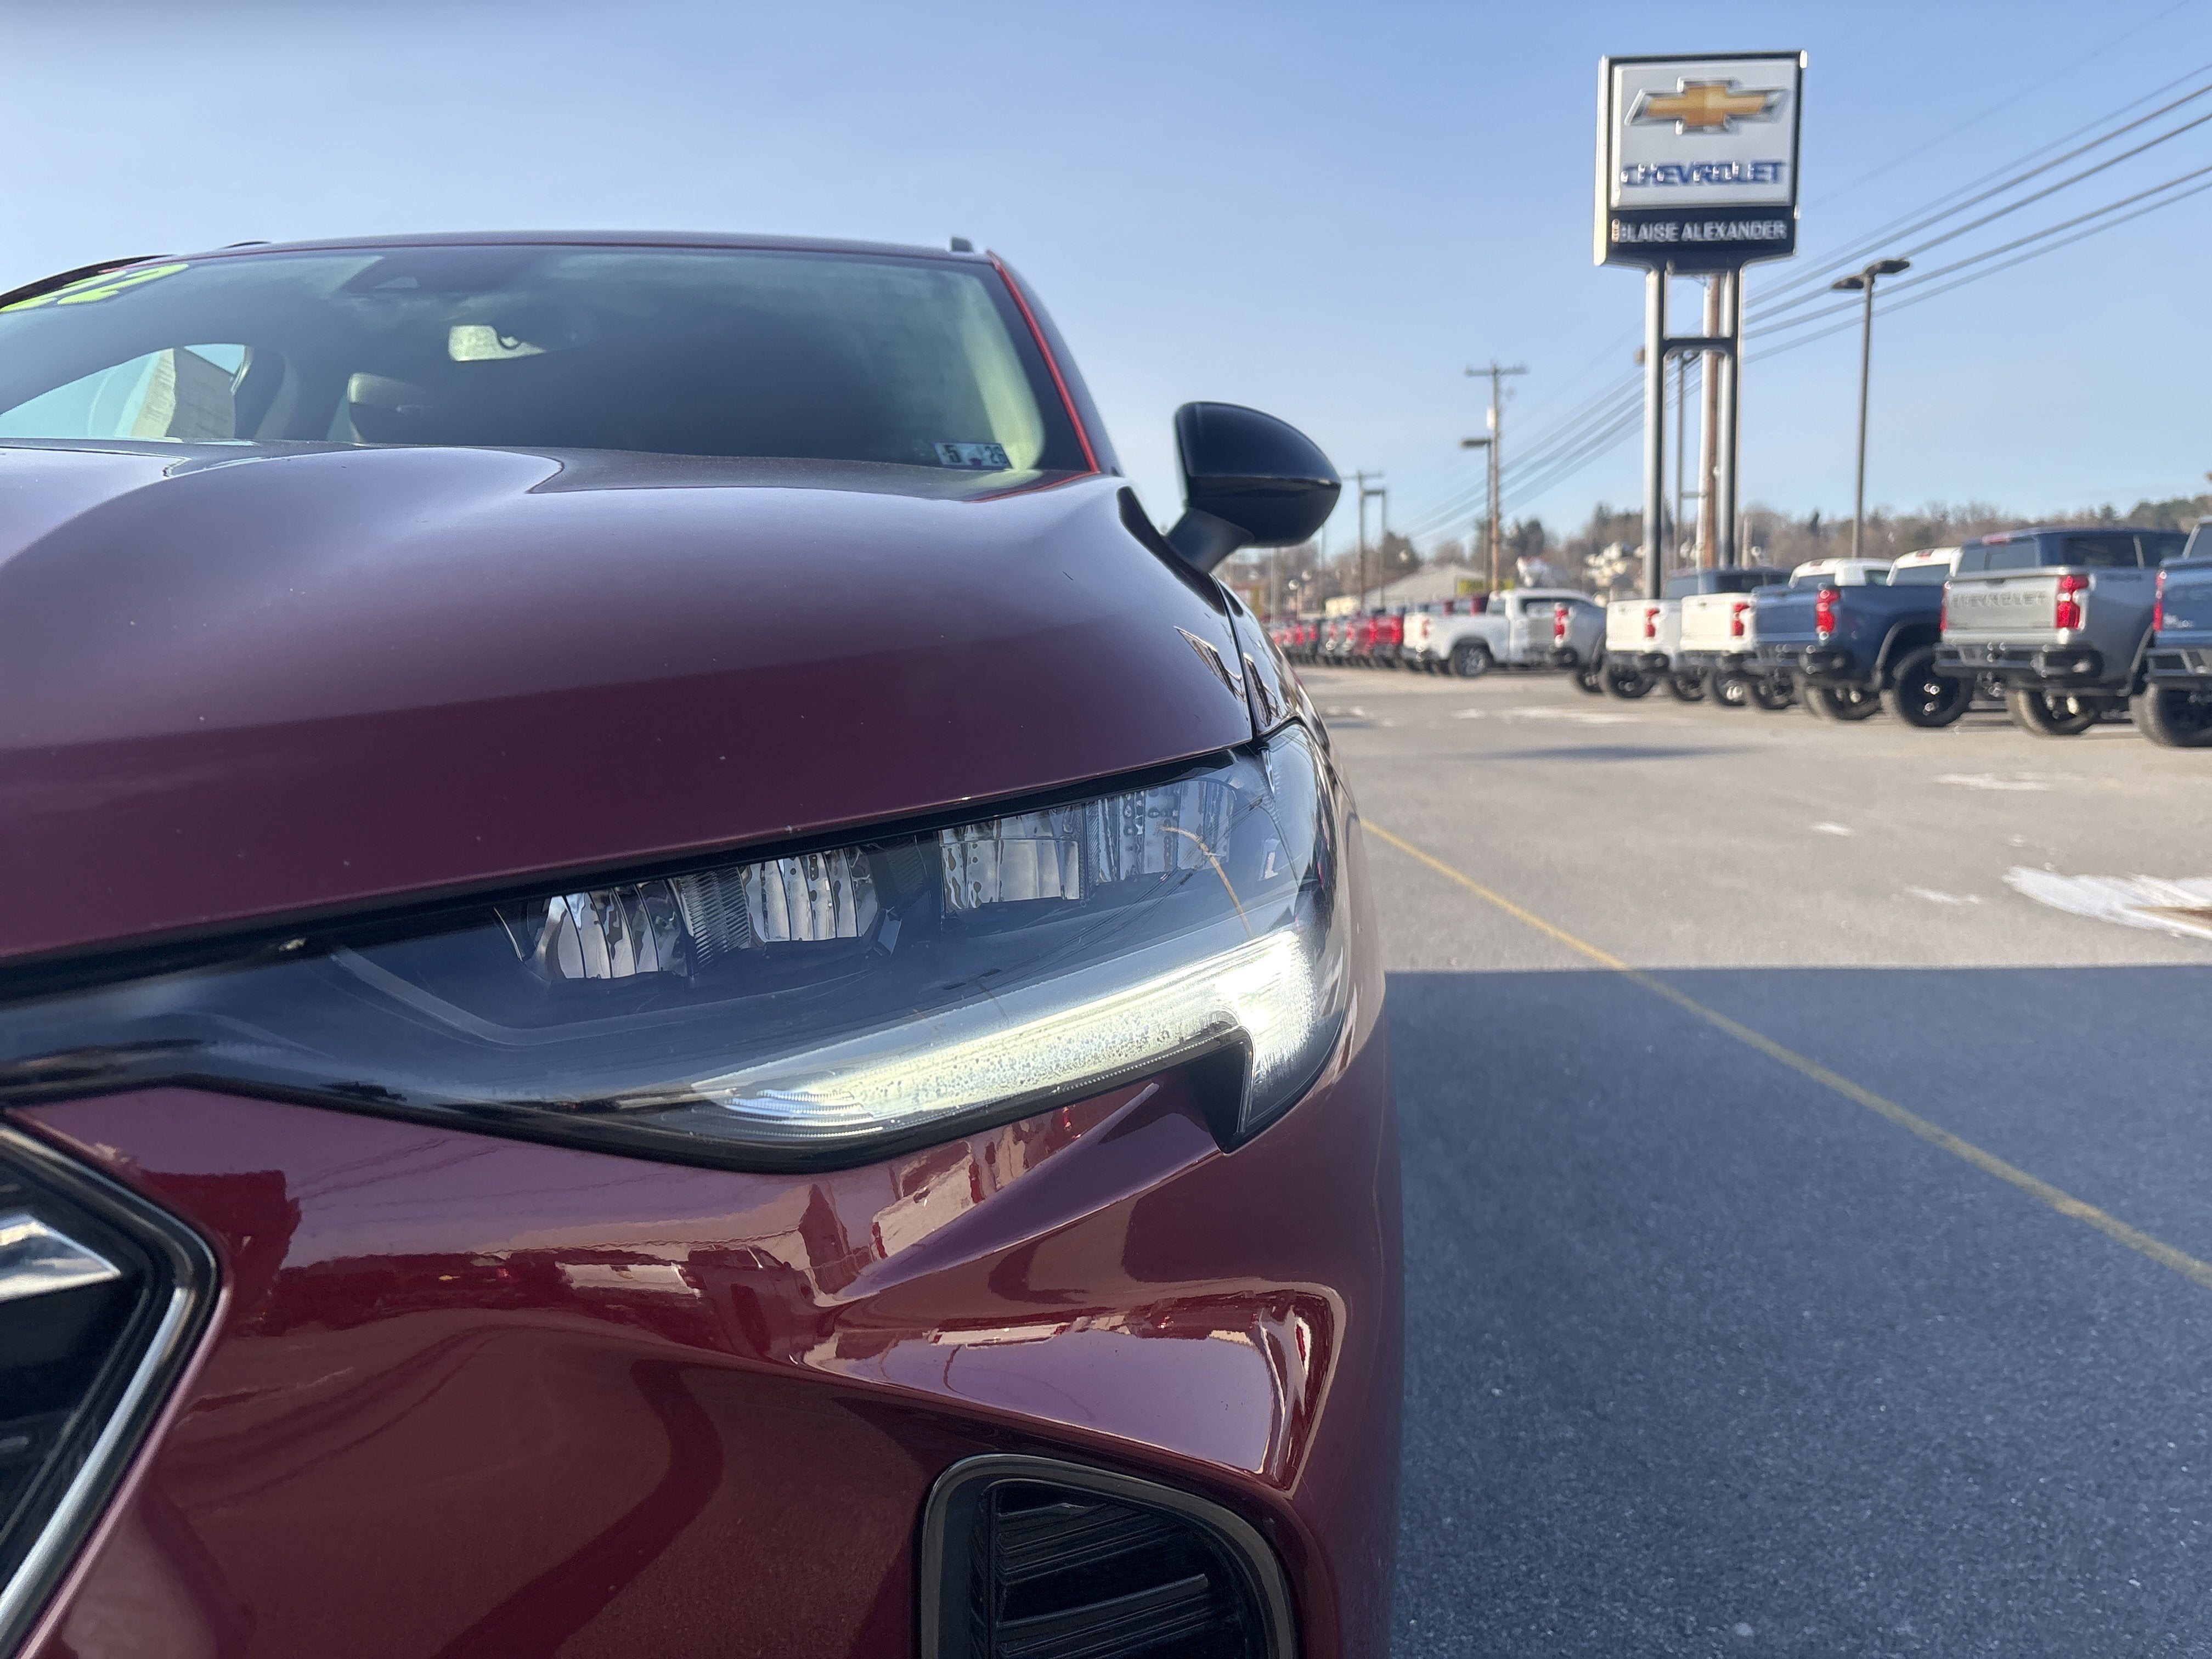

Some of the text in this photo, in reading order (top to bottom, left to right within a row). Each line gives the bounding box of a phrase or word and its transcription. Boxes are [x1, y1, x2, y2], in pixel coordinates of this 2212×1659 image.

[1620, 161, 1784, 185] CHEVROLET
[1612, 220, 1787, 243] BLAISE ALEXANDER
